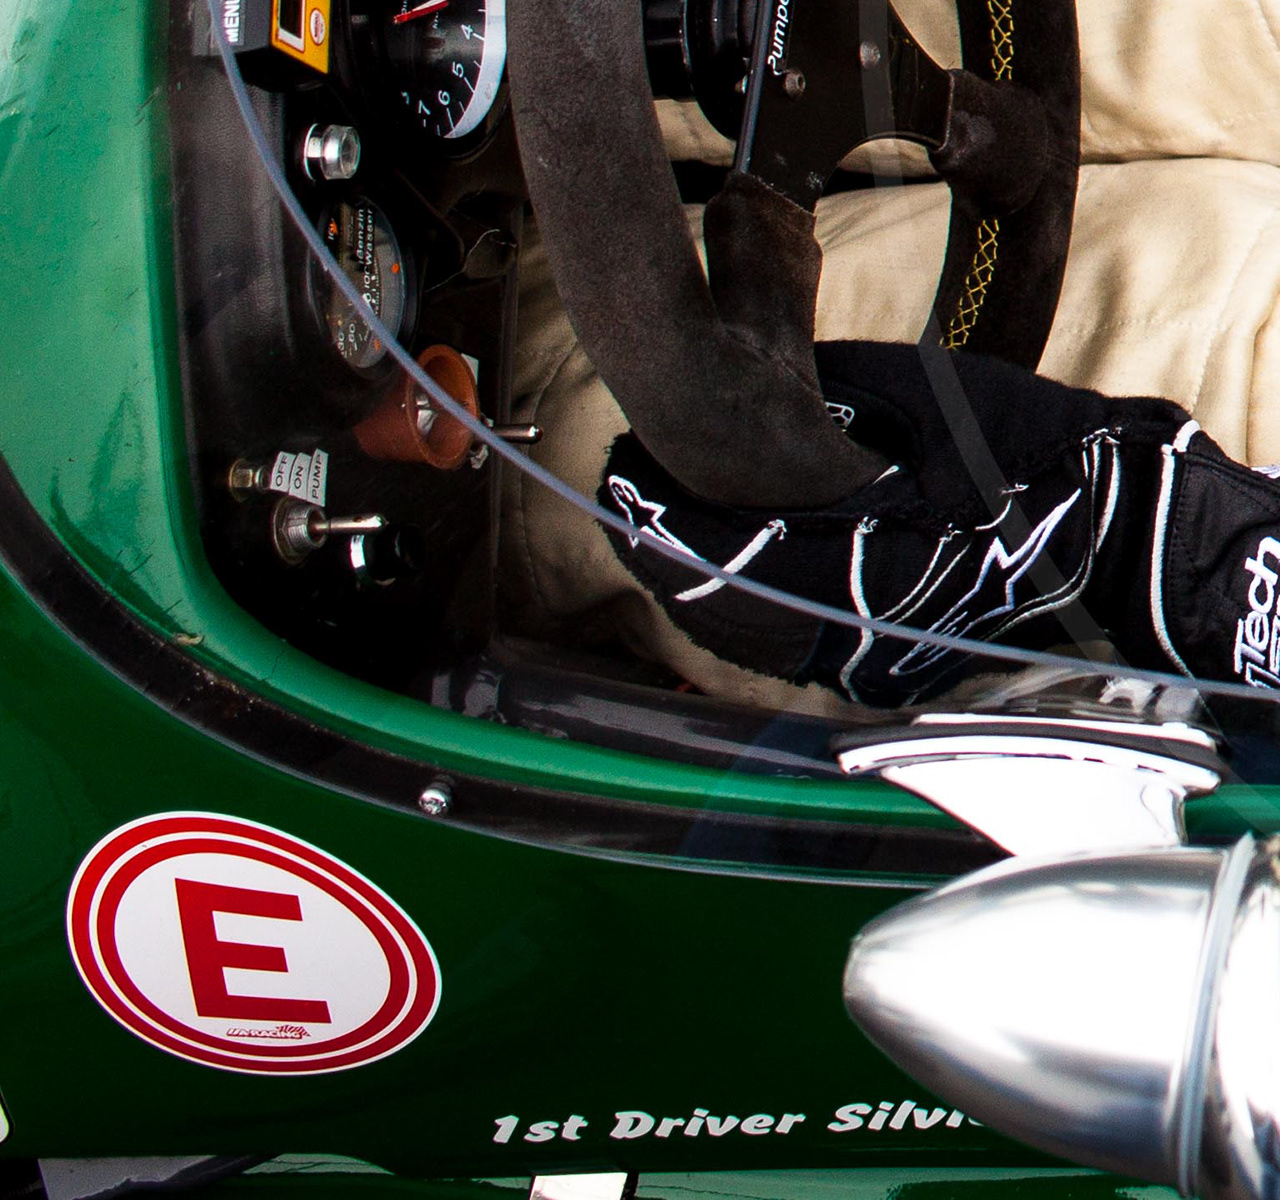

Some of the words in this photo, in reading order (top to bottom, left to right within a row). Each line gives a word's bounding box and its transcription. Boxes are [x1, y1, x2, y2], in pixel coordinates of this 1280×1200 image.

[460, 24, 474, 40] 4
[451, 61, 465, 78] 5
[437, 90, 451, 107] 6
[274, 454, 289, 488] OFF
[293, 465, 305, 490] ON
[311, 453, 322, 500] PUMP
[173, 877, 333, 1024] E
[491, 1112, 590, 1145] 1st
[609, 1108, 807, 1141] Driver
